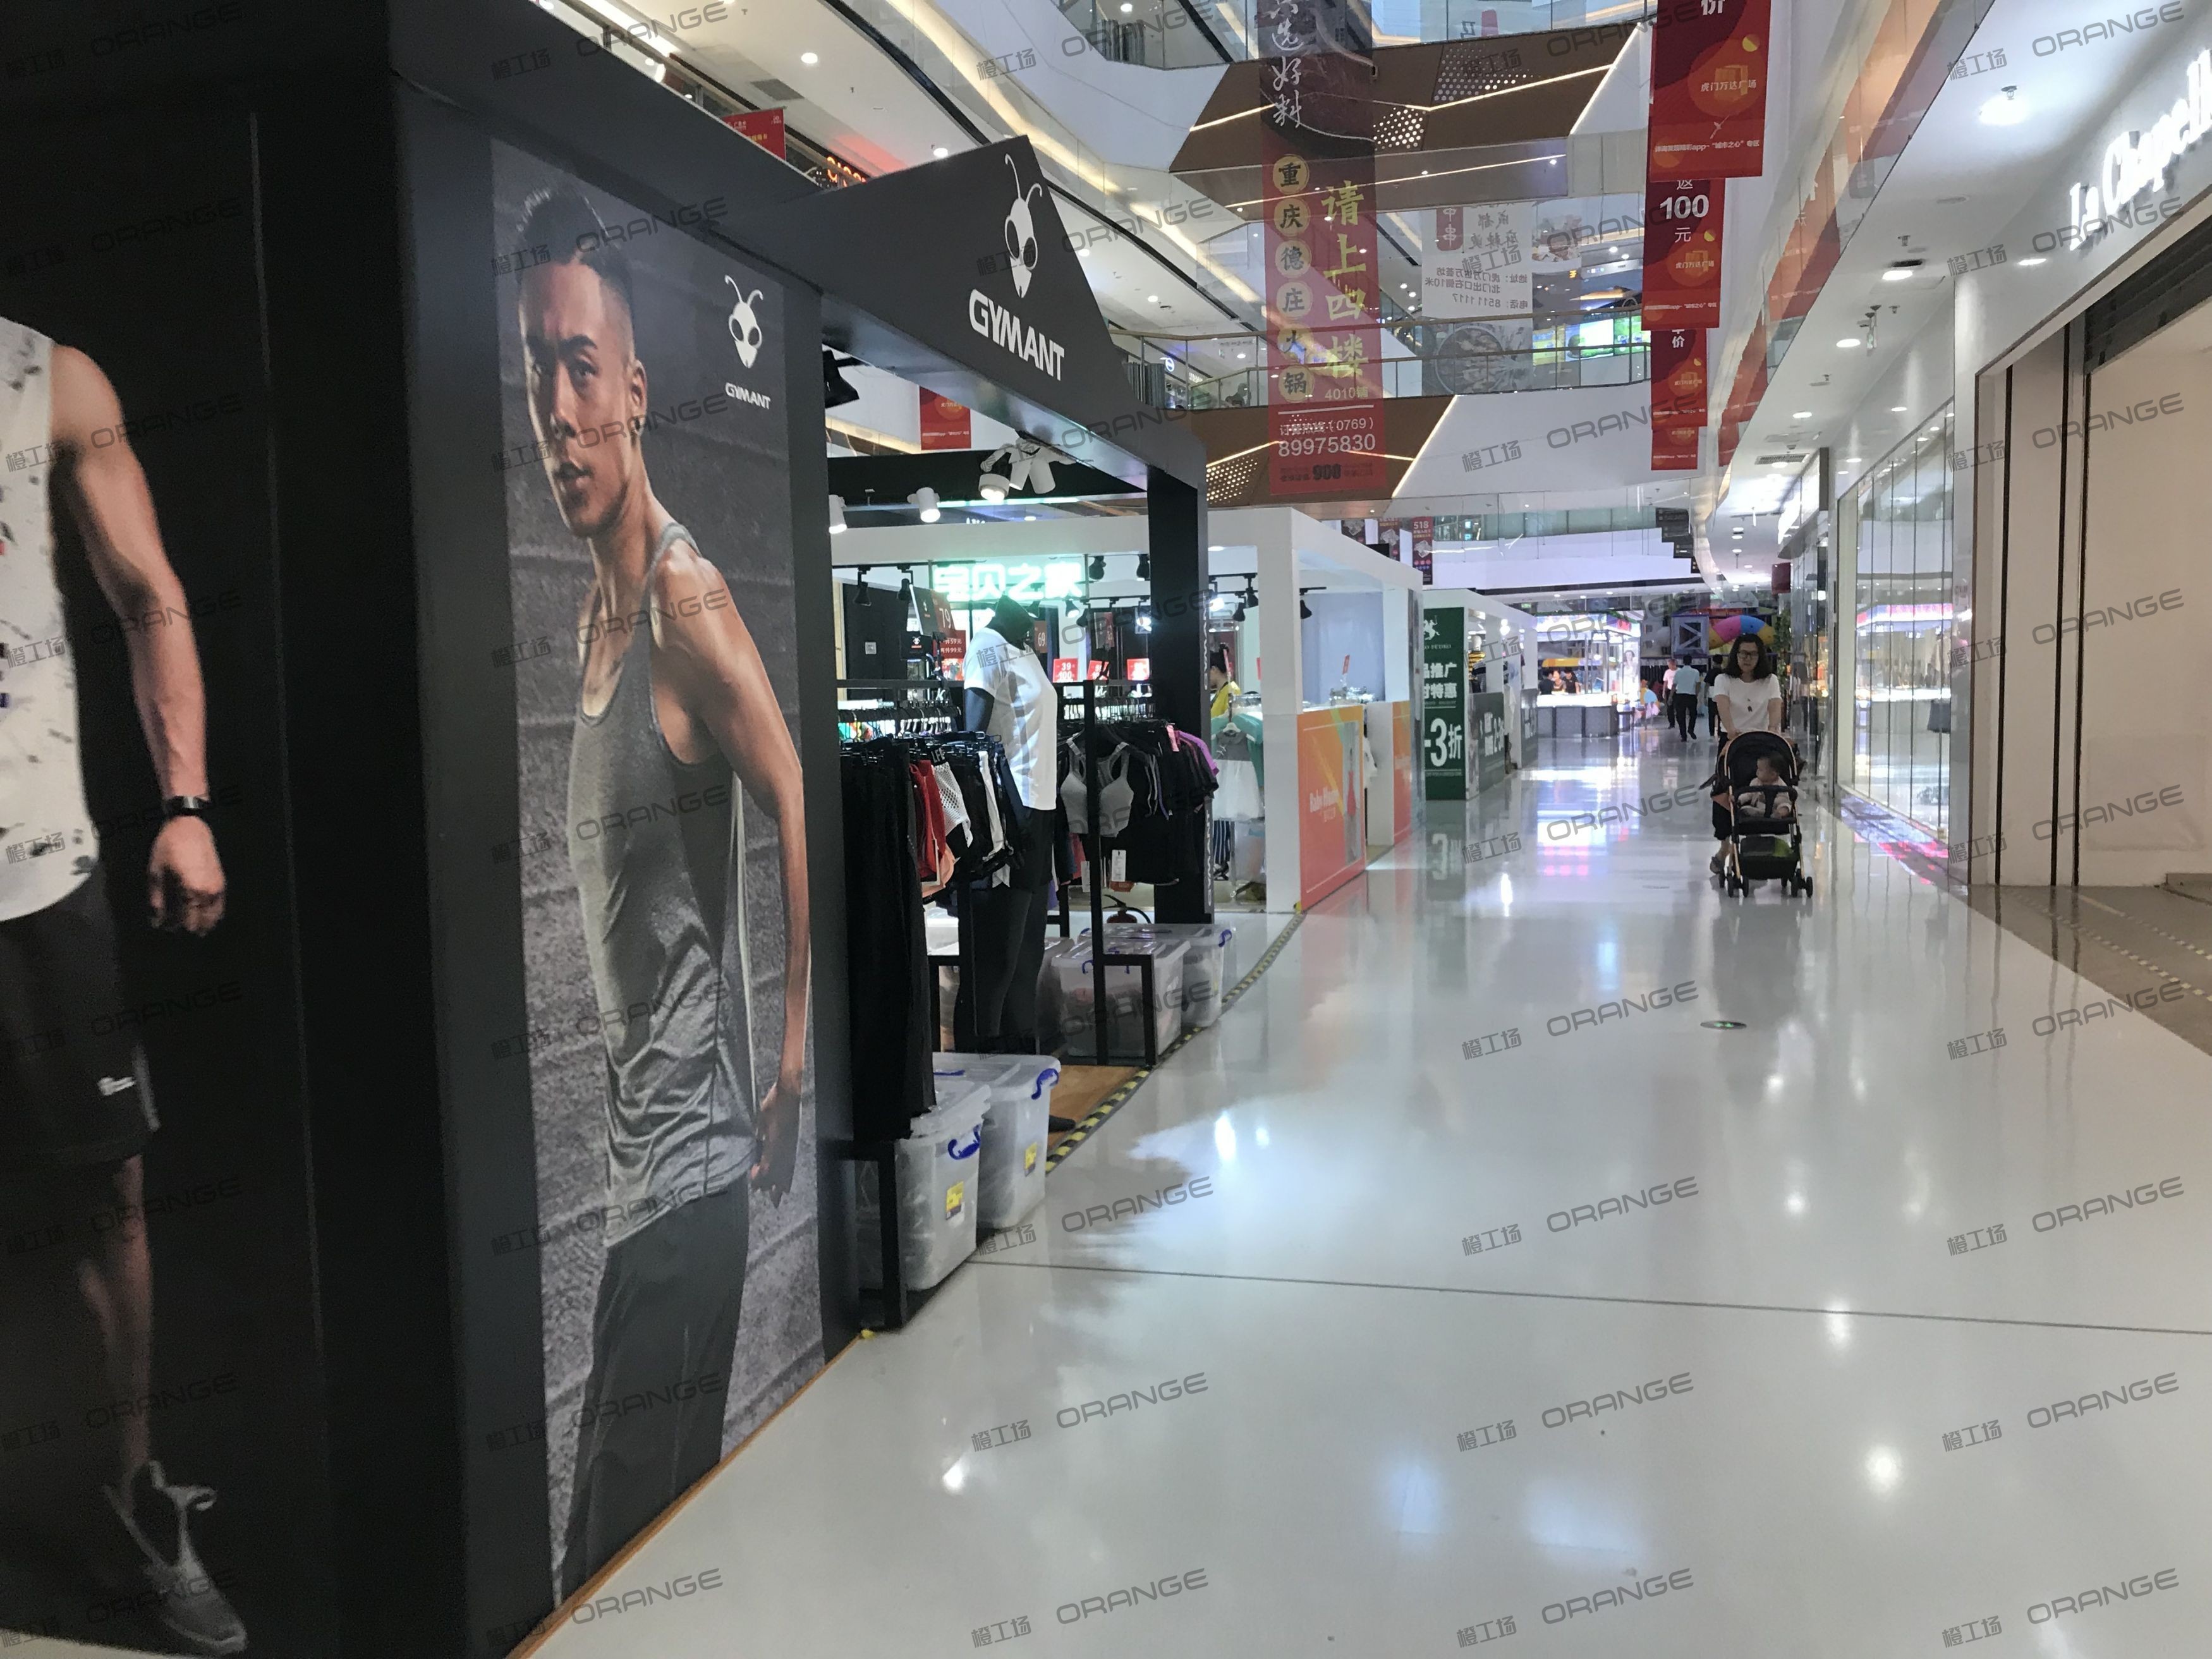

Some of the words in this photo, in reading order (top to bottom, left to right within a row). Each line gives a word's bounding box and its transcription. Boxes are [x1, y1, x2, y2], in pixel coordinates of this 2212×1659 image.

[1700, 79, 1757, 92] 虎门万达广场
[1660, 194, 1710, 220] 100
[1674, 227, 1691, 243] 元
[1321, 179, 1370, 379] 请上四楼
[969, 288, 1066, 382] GYMANT
[725, 382, 771, 410] GYMANT
[1278, 433, 1376, 458] 89975830
[1413, 521, 1430, 530] 518
[939, 607, 952, 629] 79
[1038, 631, 1046, 647] 69
[1061, 662, 1072, 670] 39
